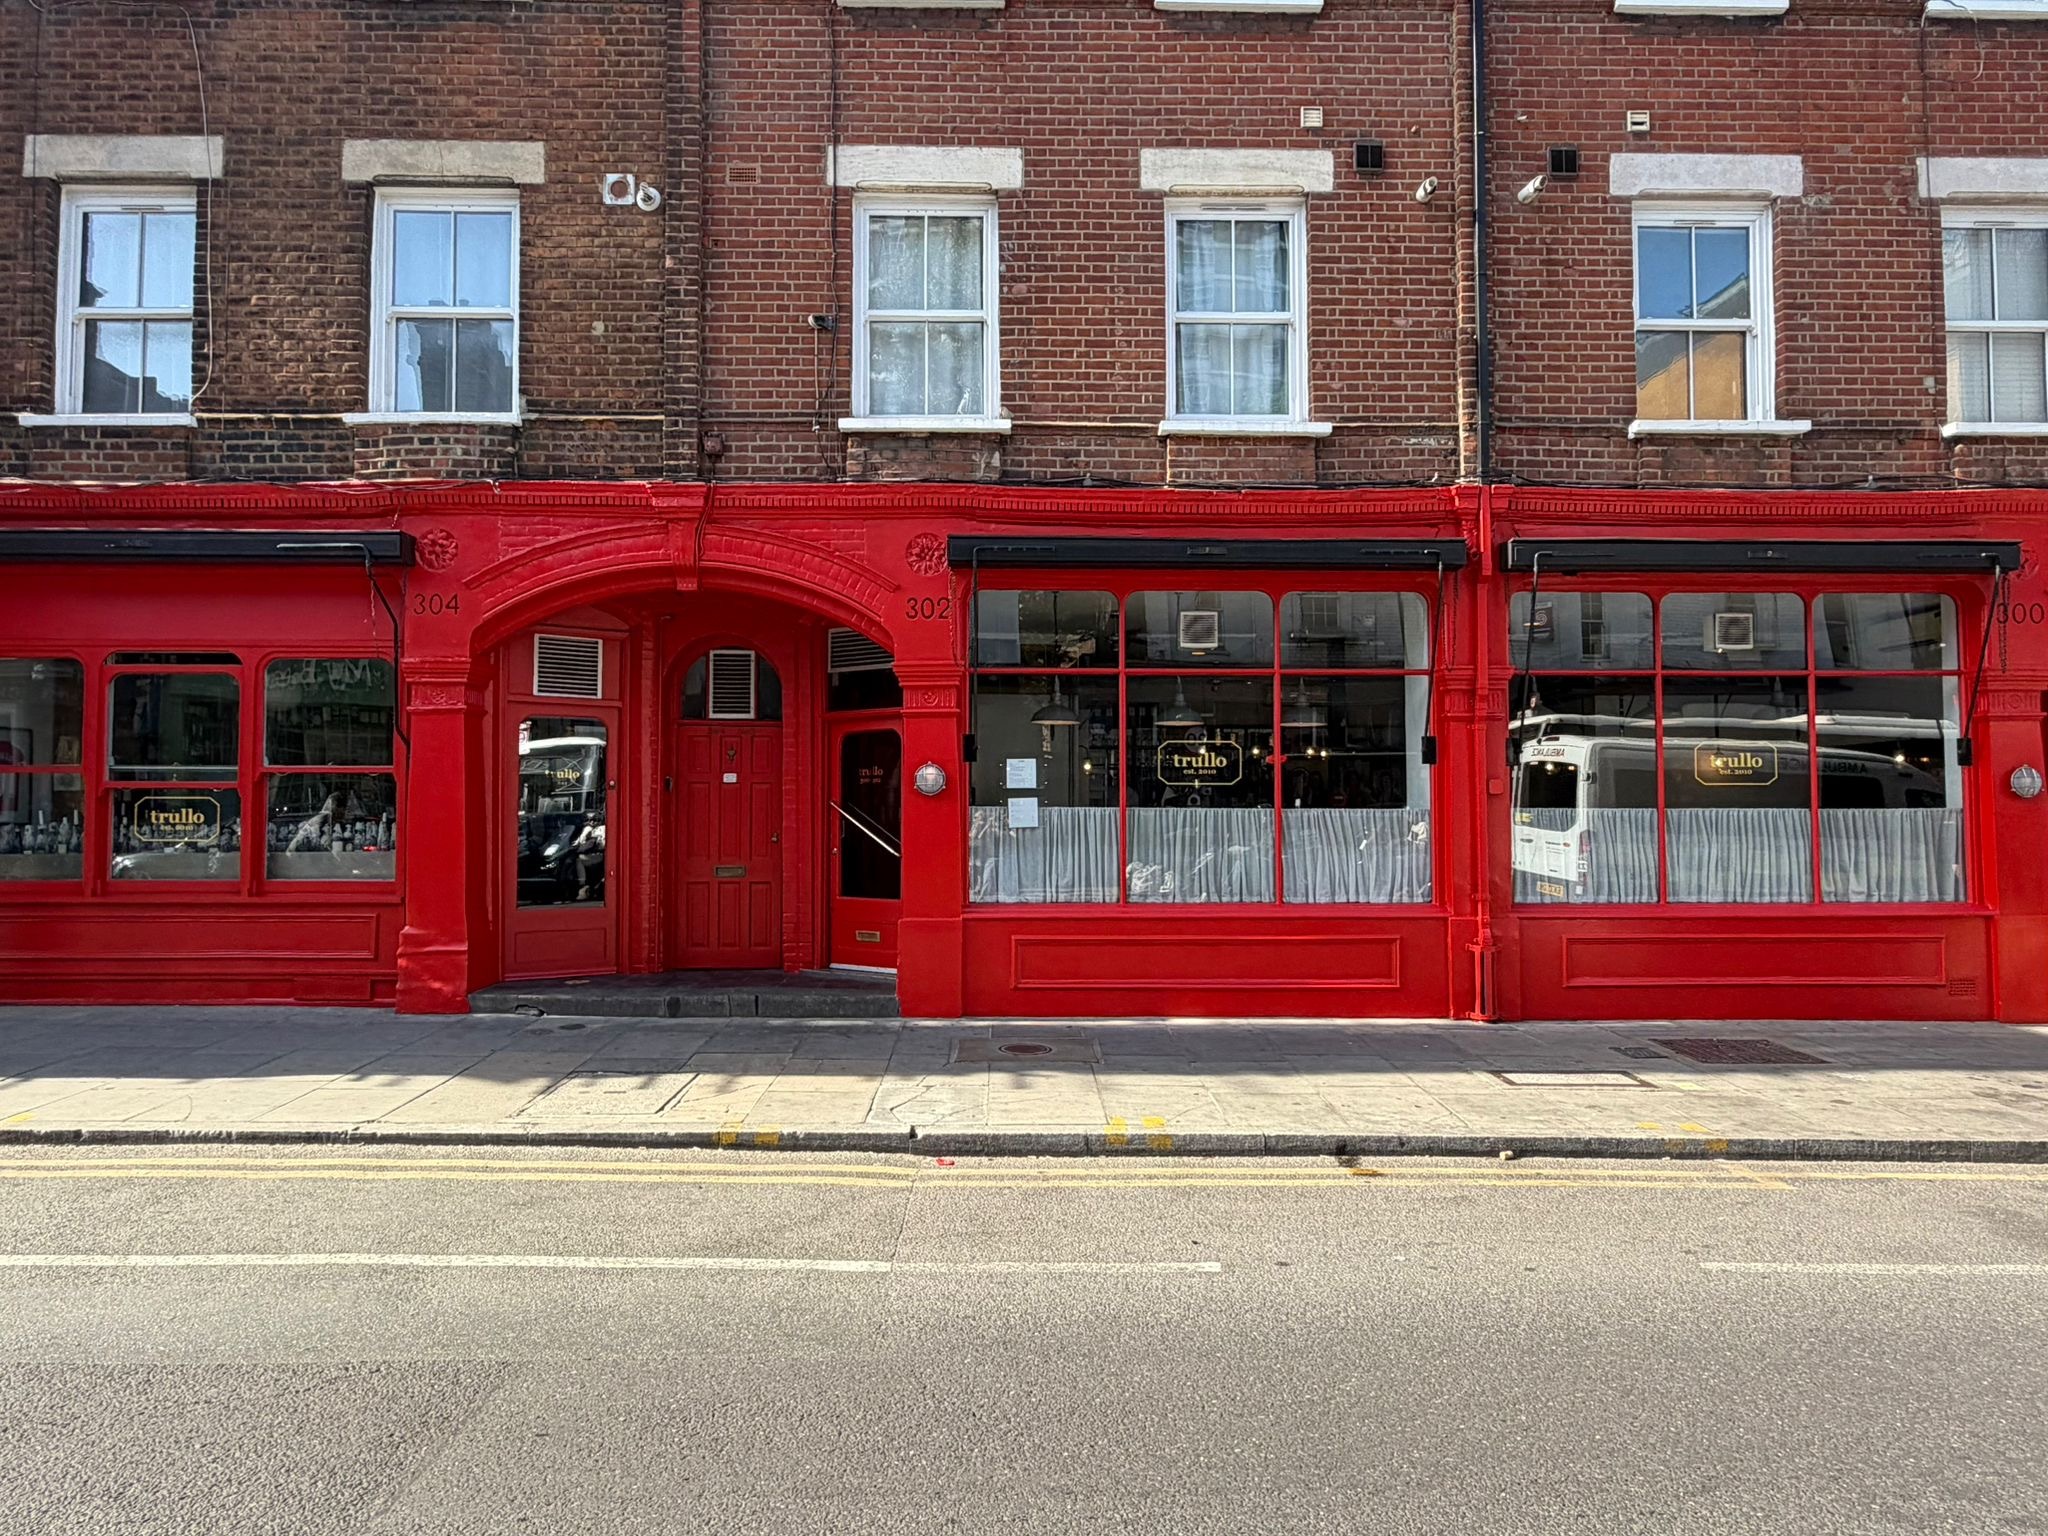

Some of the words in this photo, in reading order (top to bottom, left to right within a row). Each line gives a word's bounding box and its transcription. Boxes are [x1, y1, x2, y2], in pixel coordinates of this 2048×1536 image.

[414, 593, 459, 615] 304
[906, 597, 950, 619] 302
[1997, 603, 2045, 624] 300
[1174, 752, 1227, 768] trullo
[1710, 752, 1763, 768] trullo
[150, 808, 205, 824] trullo
